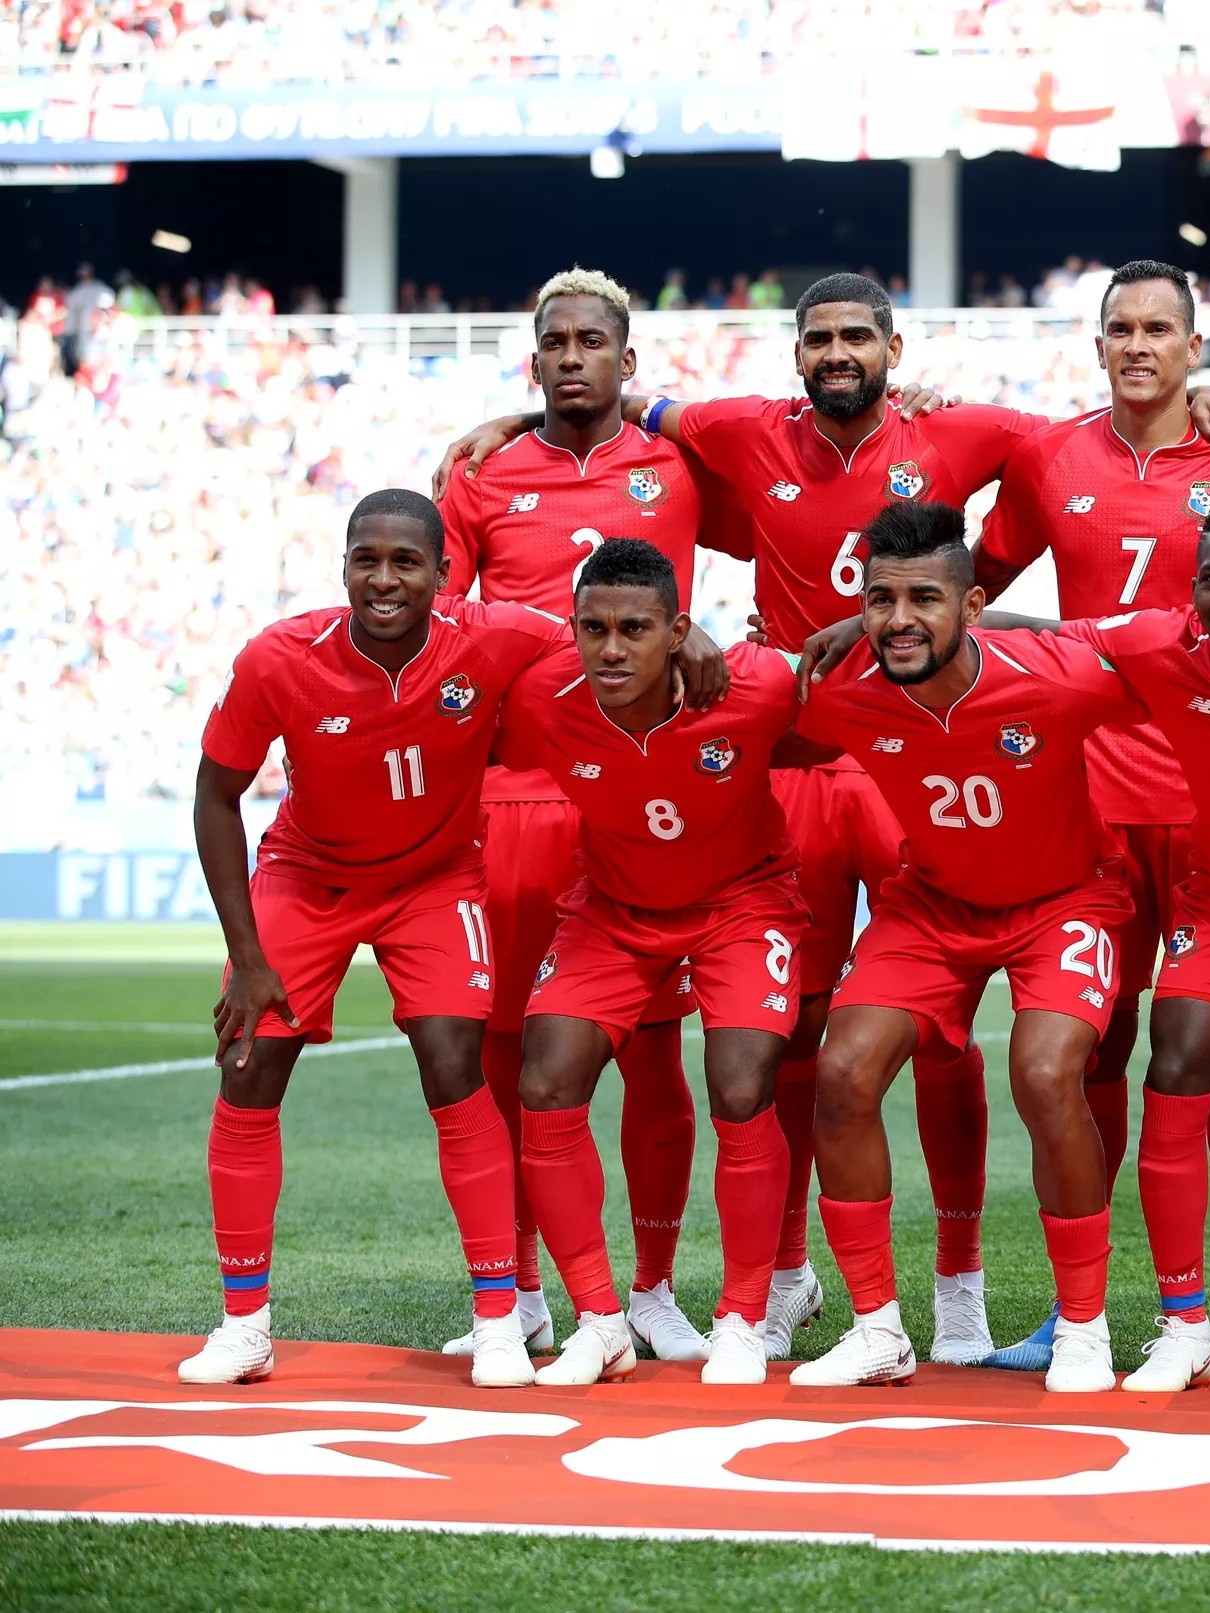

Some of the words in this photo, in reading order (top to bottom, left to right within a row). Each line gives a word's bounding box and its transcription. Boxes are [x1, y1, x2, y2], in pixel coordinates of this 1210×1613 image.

[831, 531, 865, 597] 6
[1119, 537, 1158, 605] 7
[384, 745, 425, 801] 11
[922, 775, 1003, 829] 20
[645, 798, 685, 841] 8
[56, 855, 218, 920] FIFA
[457, 899, 490, 967] 11
[763, 929, 793, 985] 8
[1060, 919, 1114, 990] 20
[220, 1251, 266, 1267] NAMÁ
